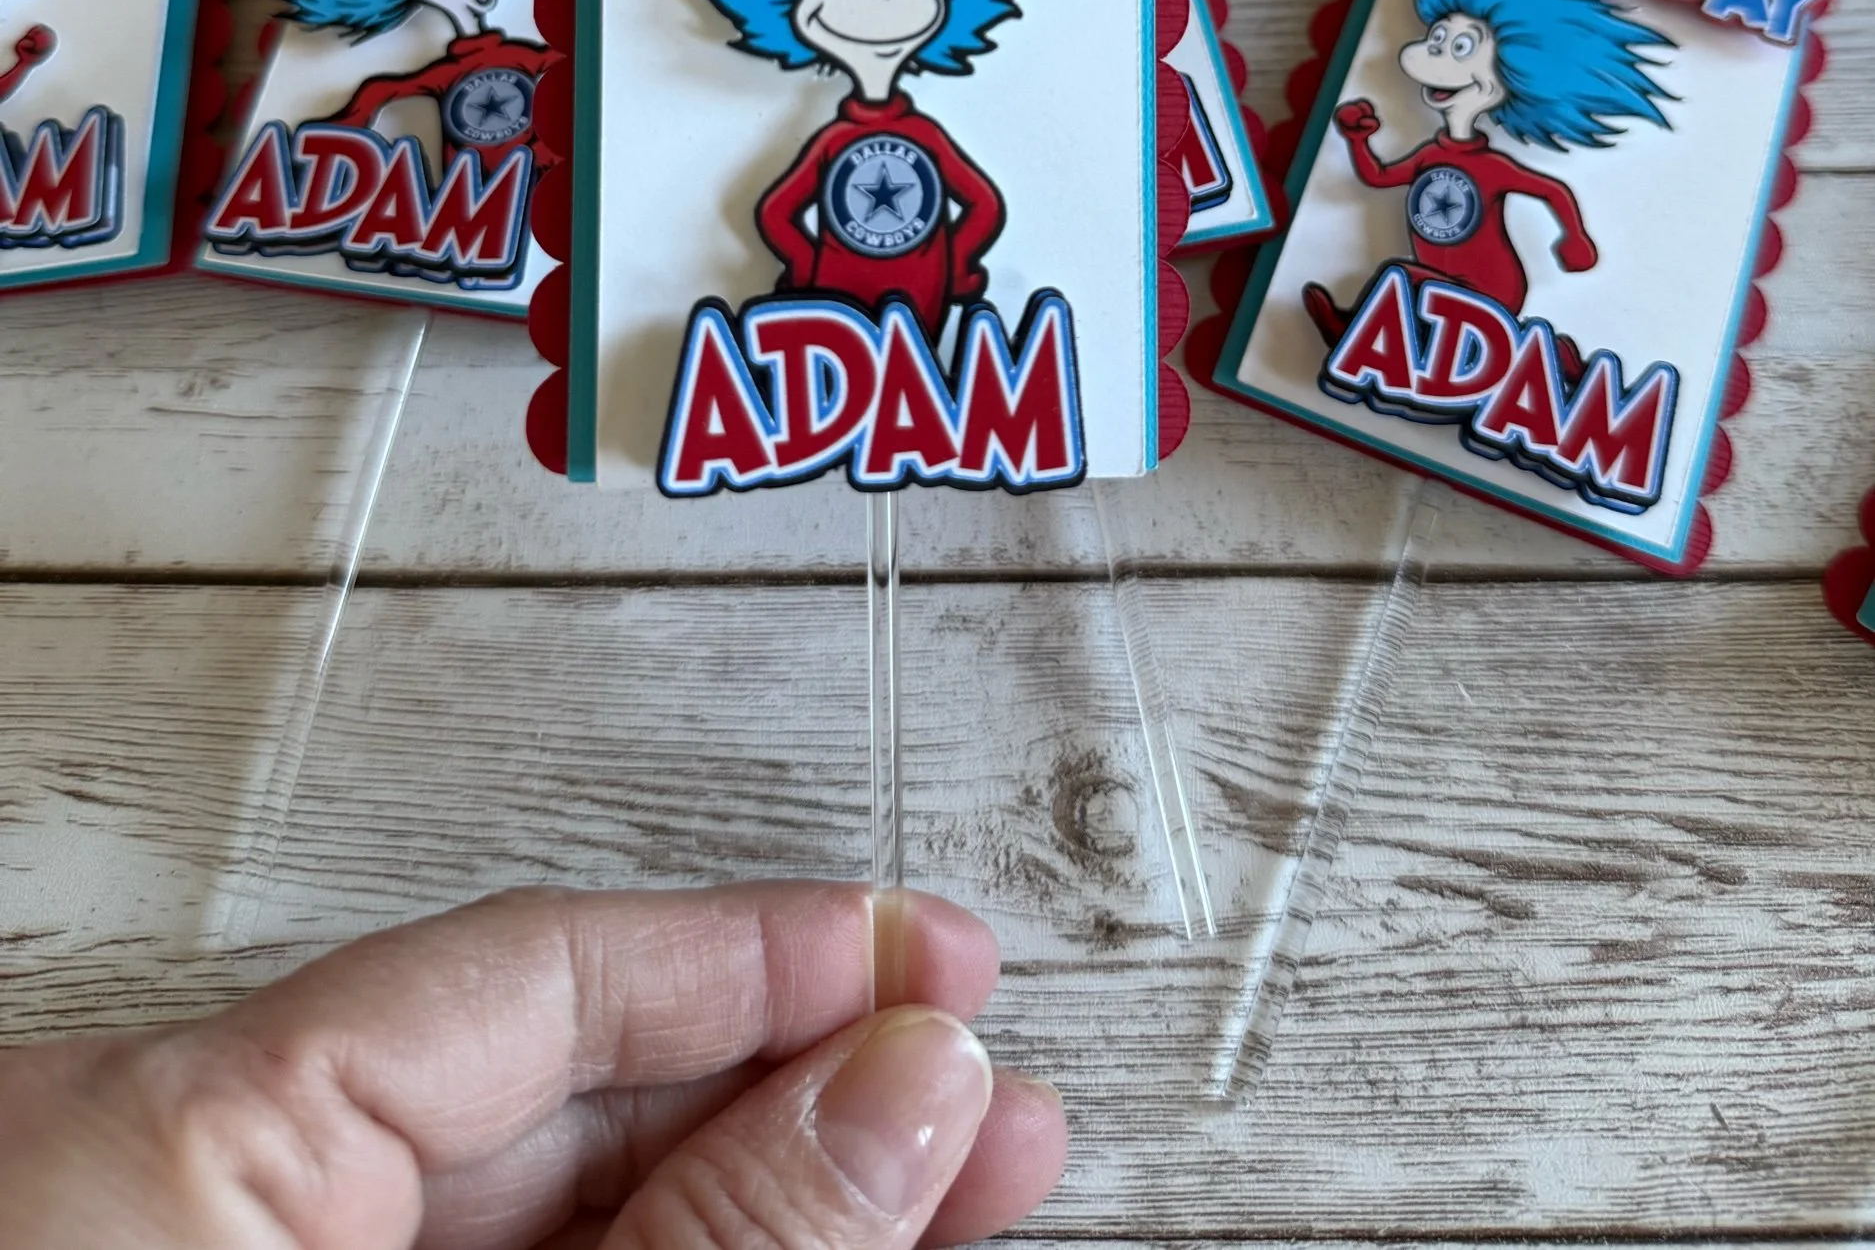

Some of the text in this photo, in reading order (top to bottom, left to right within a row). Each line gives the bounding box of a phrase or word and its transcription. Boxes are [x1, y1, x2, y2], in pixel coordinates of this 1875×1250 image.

[206, 121, 533, 273] ADAM
[850, 142, 918, 166] DALLAS
[844, 217, 926, 247] COWBOYS
[657, 287, 1087, 497] ADAM
[1320, 263, 1681, 506] ADAM
